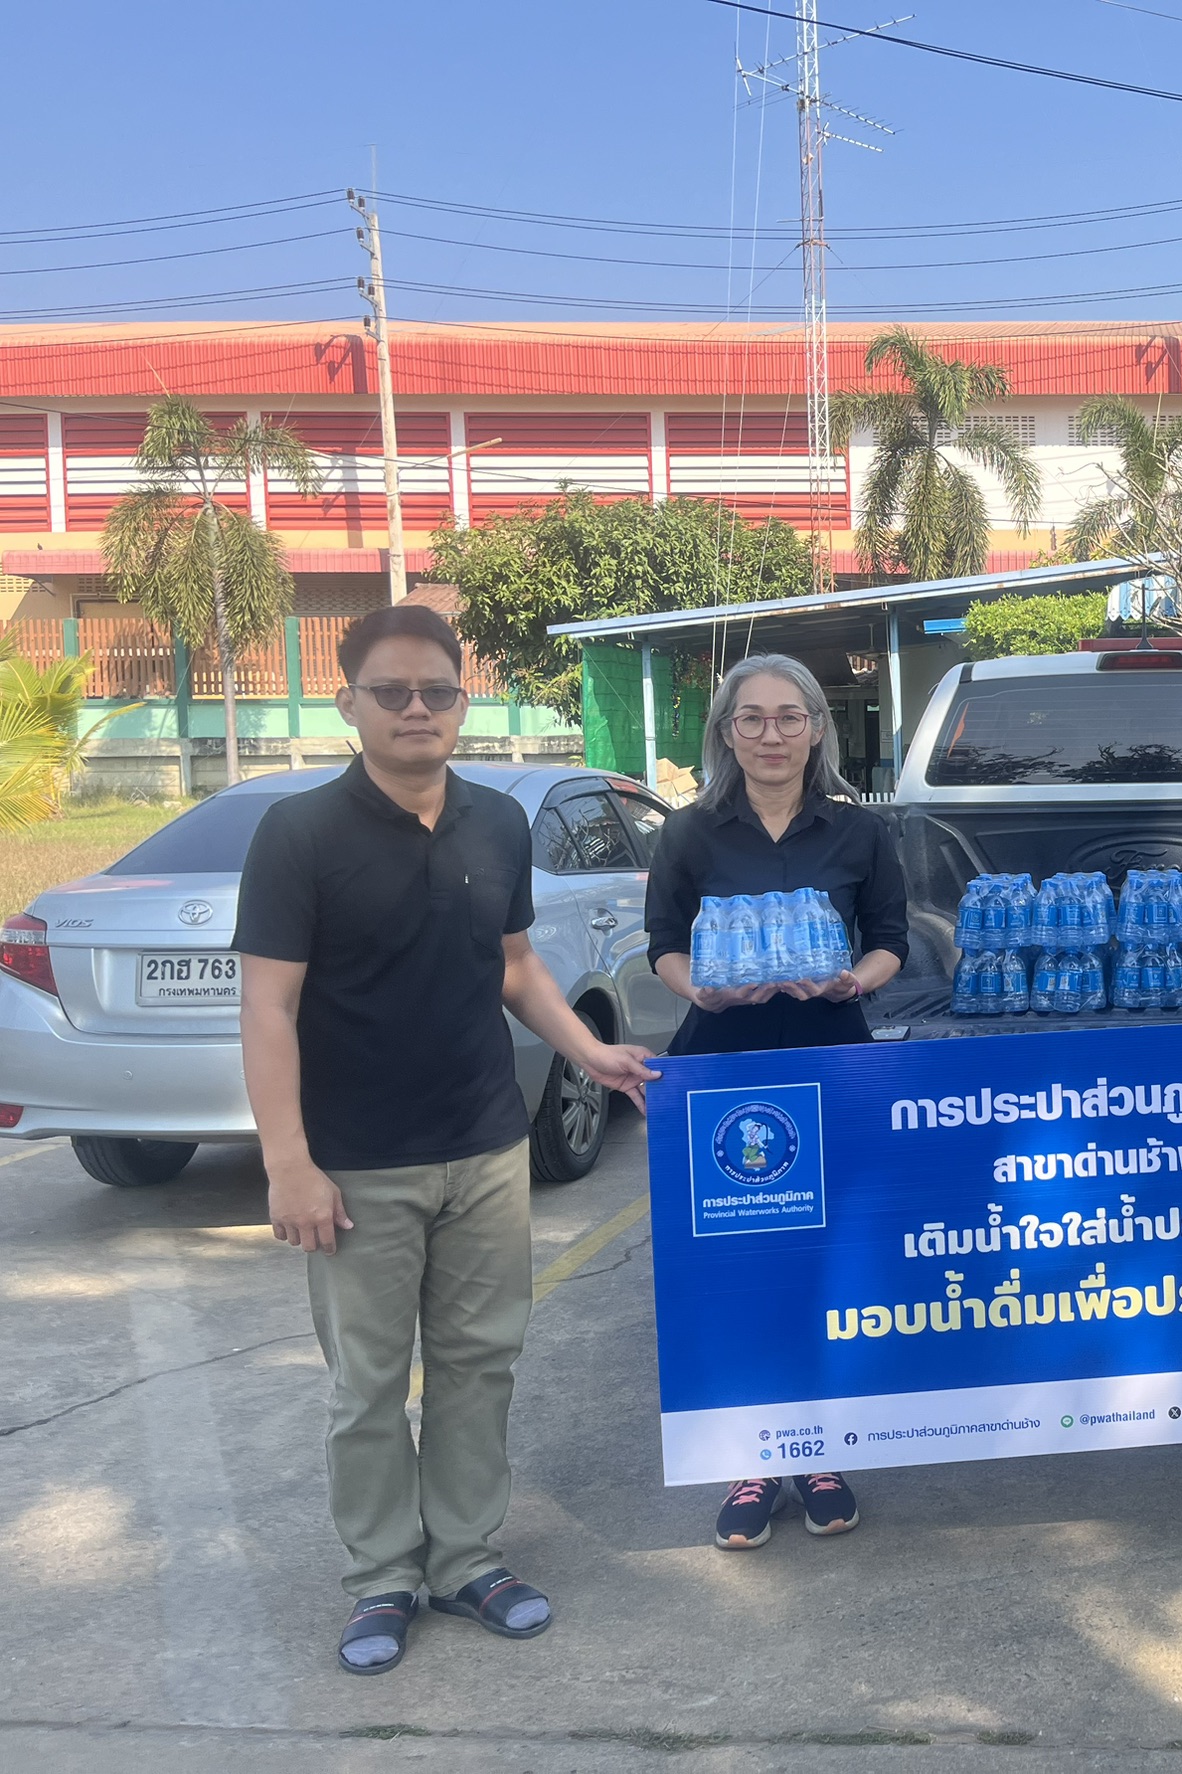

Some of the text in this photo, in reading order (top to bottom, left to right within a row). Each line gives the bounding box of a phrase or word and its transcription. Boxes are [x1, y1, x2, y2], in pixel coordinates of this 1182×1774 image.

[55, 918, 94, 928] VIOS
[146, 958, 192, 981] 2กฮ
[158, 986, 237, 997] กรงเทพมหานคร
[702, 1190, 814, 1208] การประปาส่วนภูมิภาค
[703, 1204, 814, 1219] Provincial Waterworks Authority
[1080, 1409, 1156, 1426] @pwathailand
[776, 1425, 824, 1440] pwa.co.th
[867, 1418, 1041, 1442] การประปาส่วนภูมิภาคสาขาด่านช้าง
[777, 1439, 825, 1459] 1662
